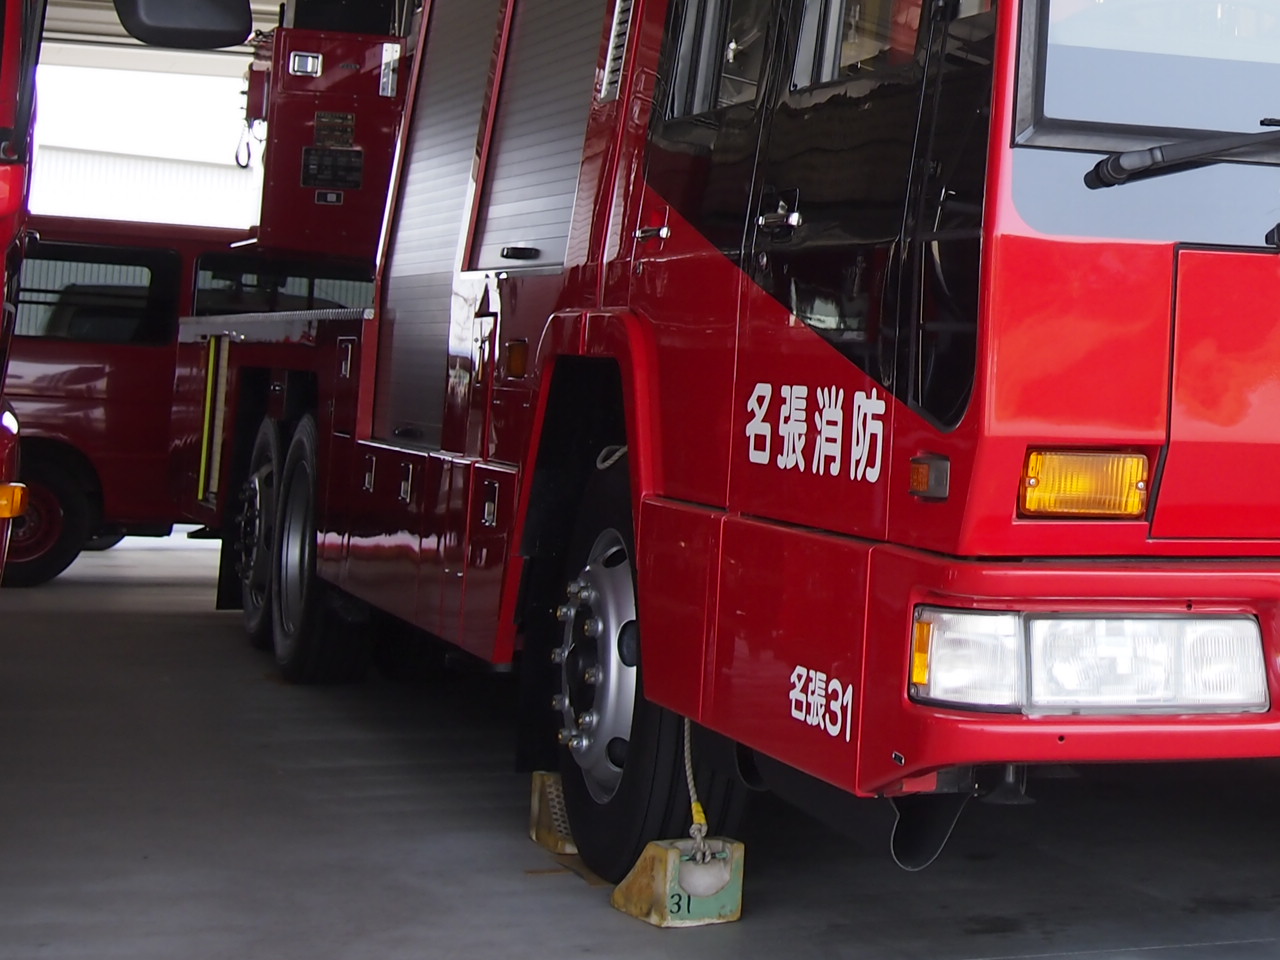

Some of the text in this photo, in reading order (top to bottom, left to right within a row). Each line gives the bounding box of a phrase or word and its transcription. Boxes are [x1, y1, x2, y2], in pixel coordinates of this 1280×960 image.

[745, 382, 887, 484] 名張消防
[788, 664, 854, 743] 名張31
[669, 893, 692, 915] 31
